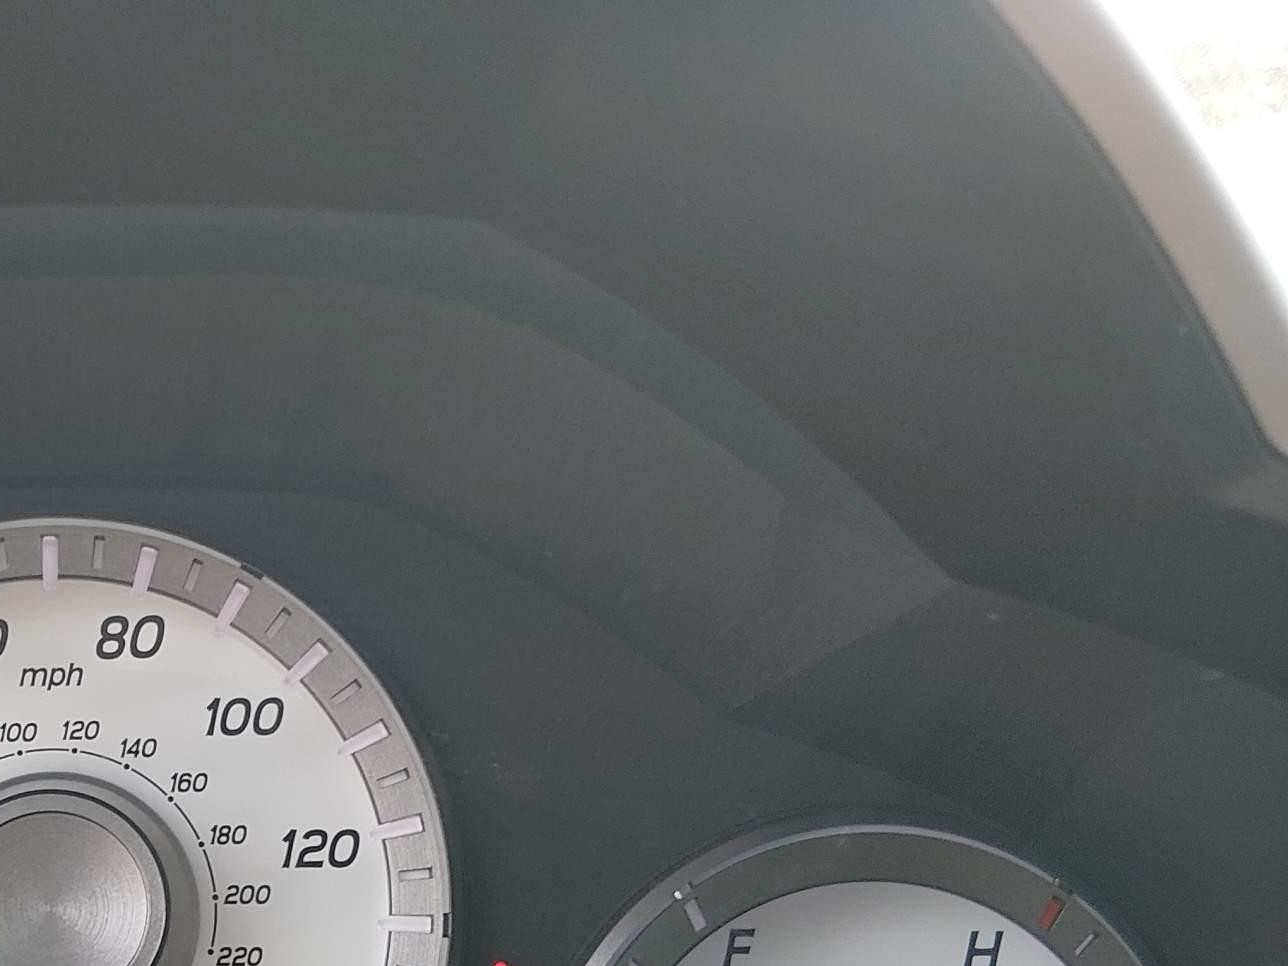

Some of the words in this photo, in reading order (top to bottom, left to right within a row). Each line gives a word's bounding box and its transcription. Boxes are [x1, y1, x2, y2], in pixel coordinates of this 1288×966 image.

[96, 615, 165, 660] 80
[19, 663, 84, 690] mph
[205, 697, 284, 736] 100
[0, 723, 38, 742] 100
[62, 721, 100, 740] 120
[120, 738, 157, 758] 140
[170, 773, 208, 792] 160
[209, 825, 247, 845] 180
[281, 829, 361, 869] 120
[223, 885, 271, 905] 200
[216, 946, 263, 966] 220
